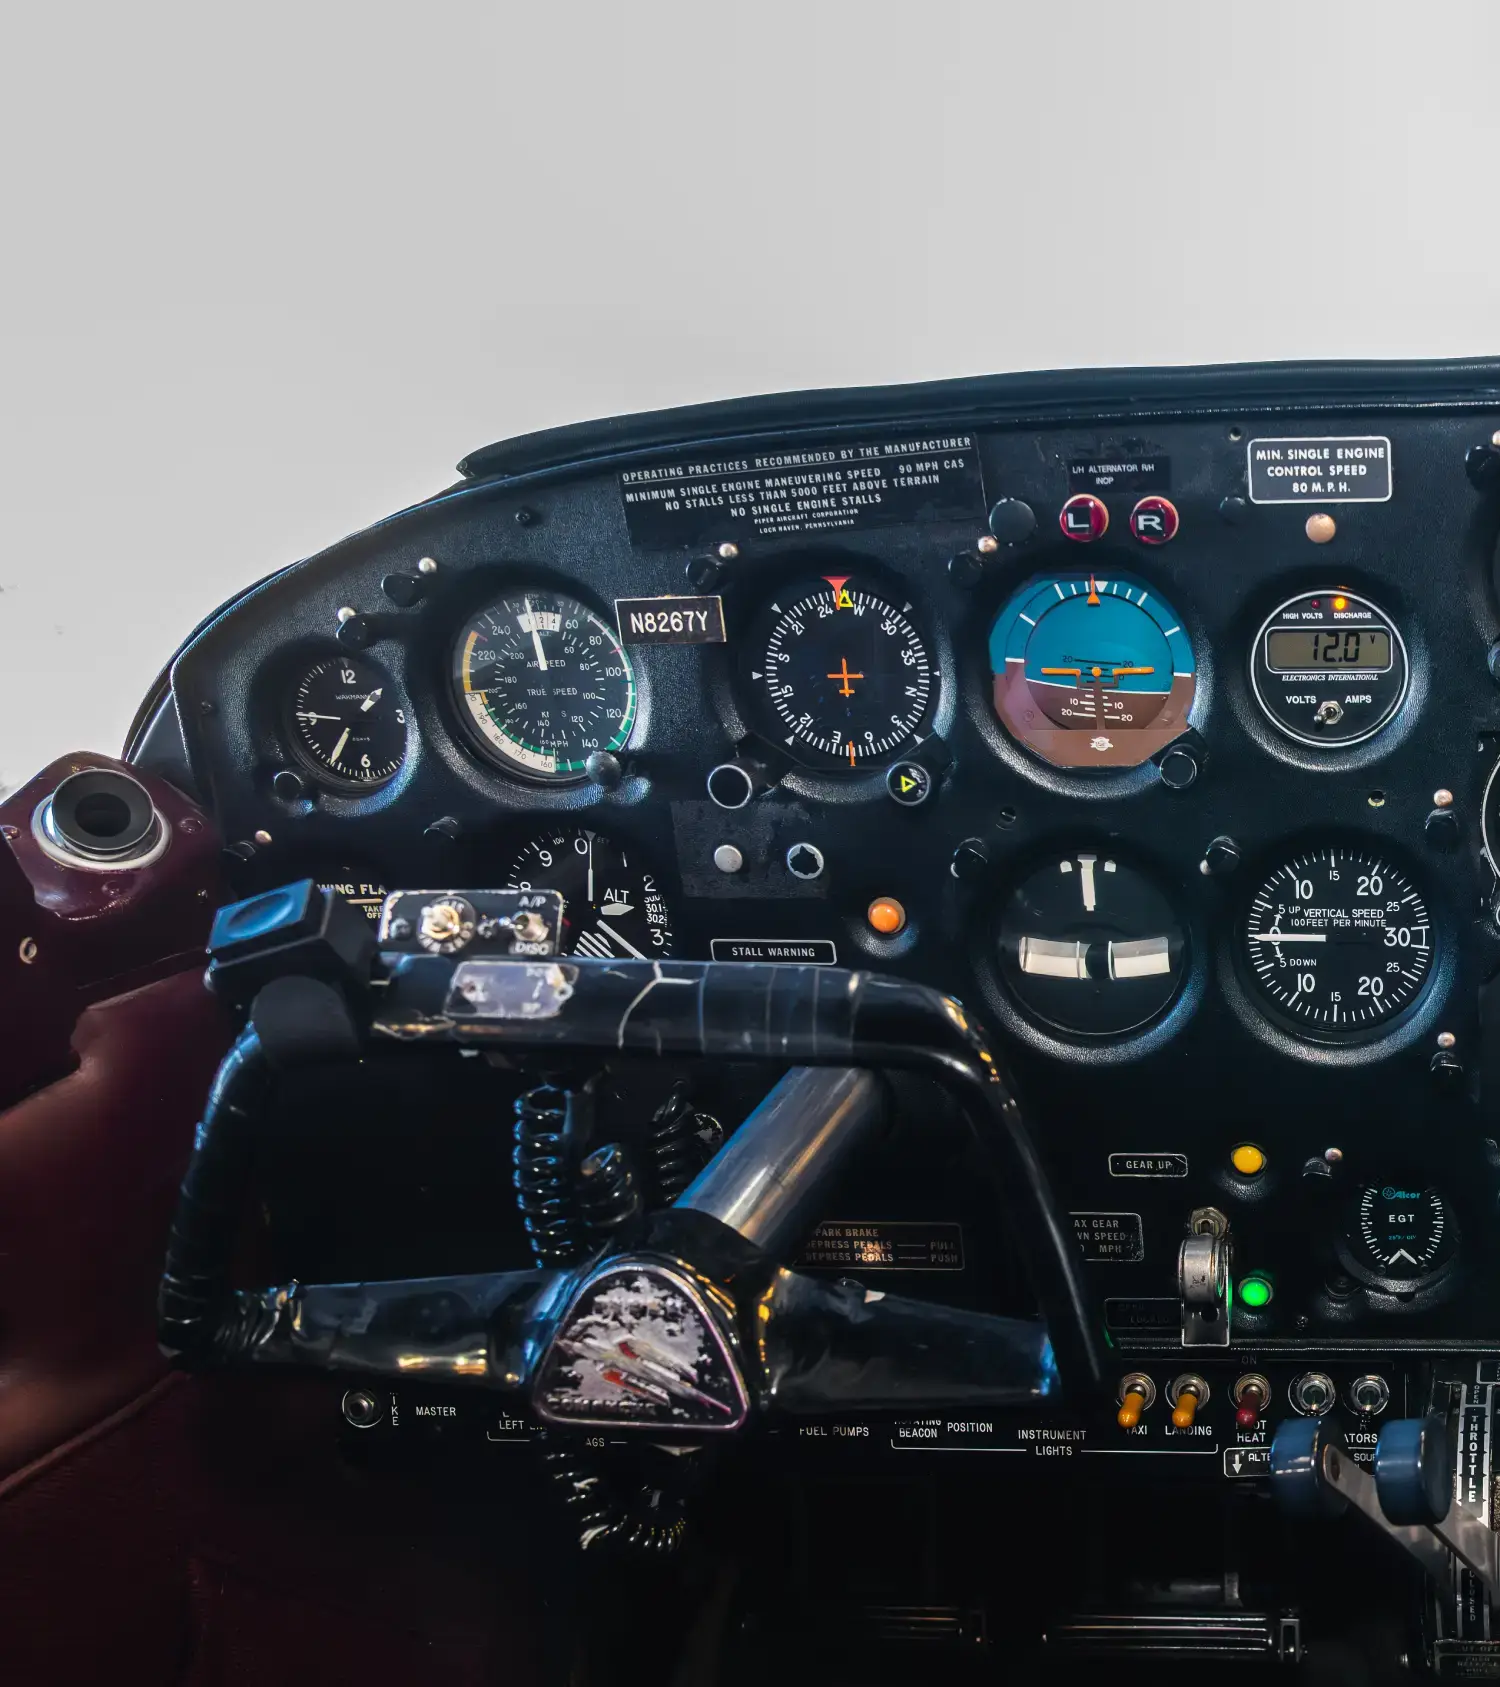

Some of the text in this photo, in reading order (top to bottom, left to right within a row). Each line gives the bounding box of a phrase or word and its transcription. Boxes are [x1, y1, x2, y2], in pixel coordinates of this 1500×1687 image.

[623, 437, 971, 482] OPERATING PRACTICES RECOMMENDED BY THE MANUFACTURER
[1256, 448, 1384, 460] MIN. SINGLE ENGINE
[1073, 464, 1155, 474] L/H ALTERNATOR R/H
[1267, 465, 1367, 476] CONTROL SPEED
[626, 458, 965, 502] MINIMUM SINGLE ENGINE MANEUVERING SPEED 90 MPH CAS
[1096, 477, 1114, 485] INOP
[665, 474, 940, 511] NO STALLS LESS THAN 5000 FEET ABOVE TERRAIN
[1293, 482, 1307, 493] 80
[731, 494, 882, 517] NO SINGLE ENGINE STALLS
[1068, 513, 1089, 529] L
[1138, 516, 1163, 531] R
[631, 611, 707, 633] N8267Y
[1313, 633, 1360, 662] 12.0
[1286, 696, 1316, 704] VOLTS
[1304, 909, 1384, 918] VERTICAL SPEED
[731, 946, 815, 958] STALL WARNING
[1126, 1160, 1172, 1170] GEAR UP
[1389, 1215, 1414, 1223] EGT
[416, 1406, 456, 1417] MASTER
[947, 1422, 993, 1433] POSITION
[1018, 1428, 1086, 1441] INSTRUMENT
[1035, 1445, 1072, 1457] LIGHTS
